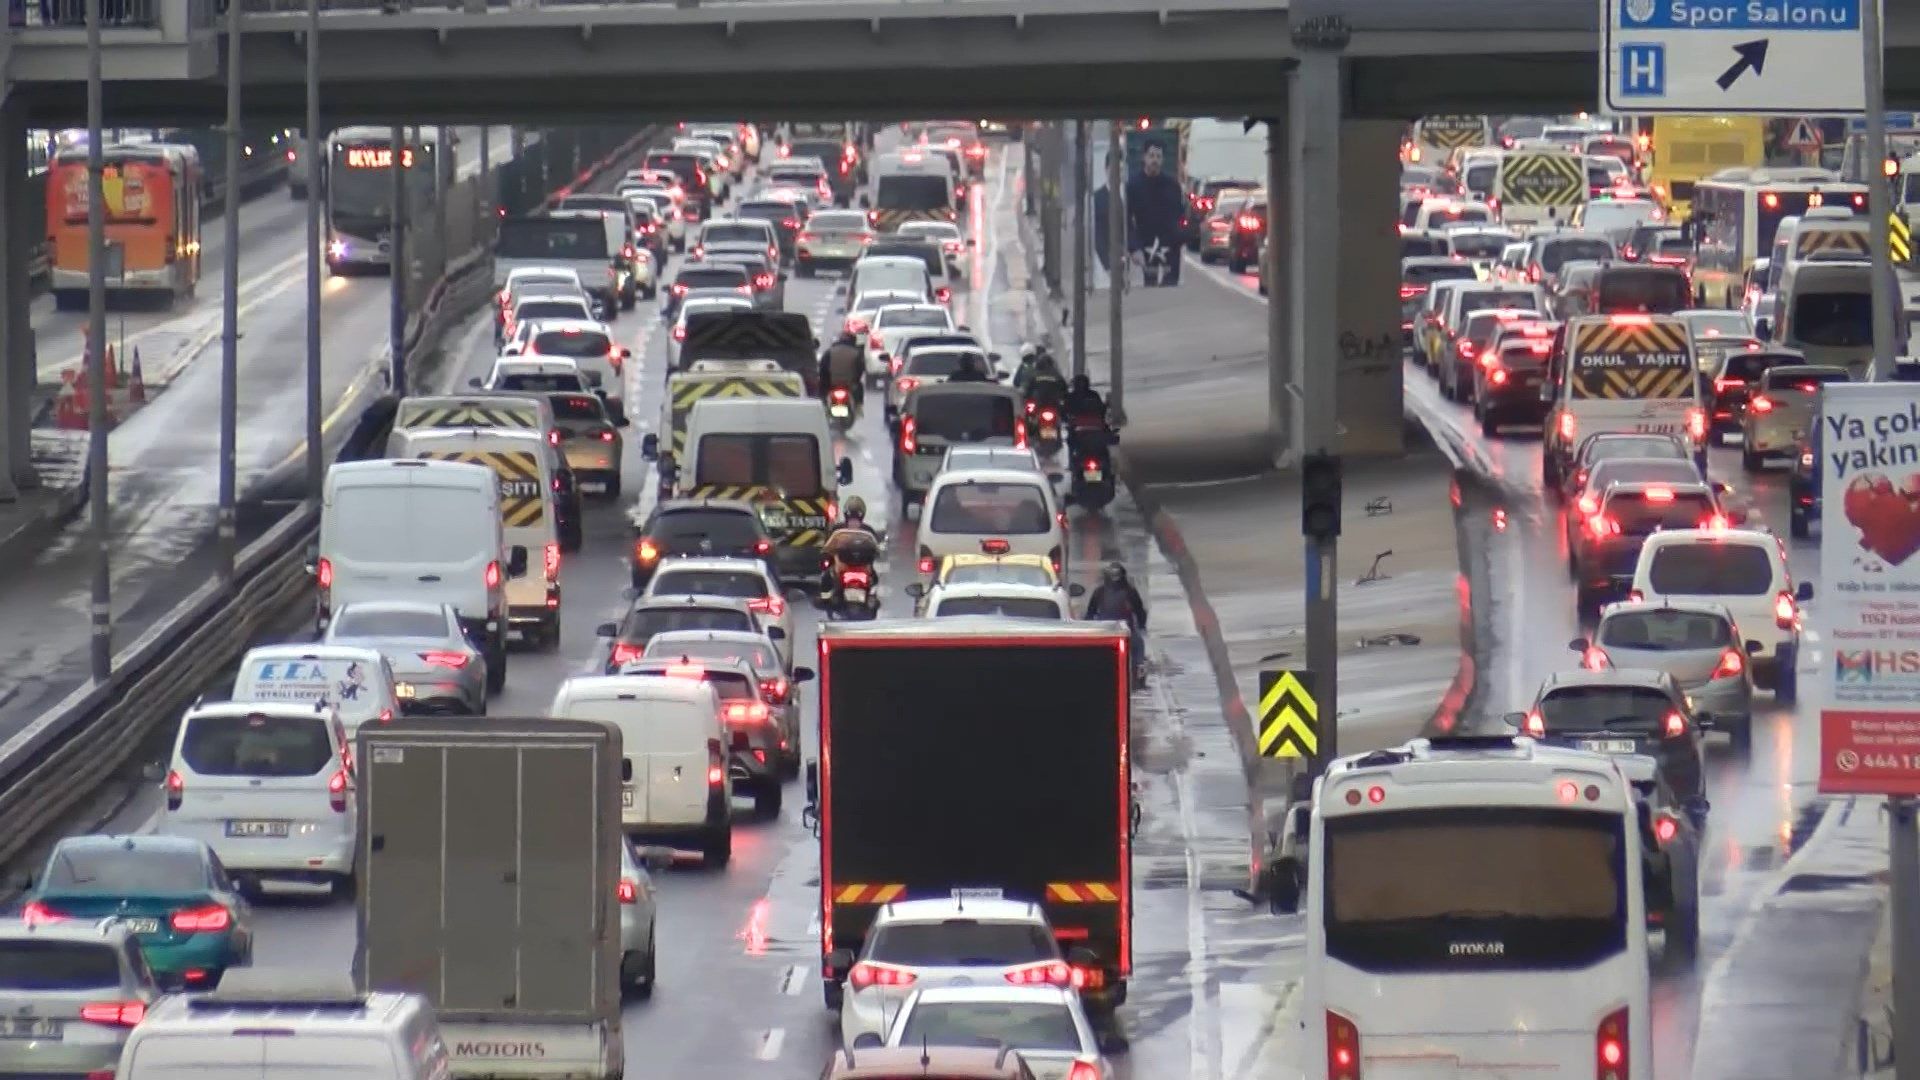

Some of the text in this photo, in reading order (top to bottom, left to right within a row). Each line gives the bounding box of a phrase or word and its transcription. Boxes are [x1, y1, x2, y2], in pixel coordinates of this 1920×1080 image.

[1670, 1, 1846, 27] Spor Salonu
[1630, 49, 1656, 88] H
[1580, 353, 1687, 368] OKUL TAŞITI
[1826, 413, 1866, 442] Ya
[1863, 754, 1899, 768] 444
[1449, 941, 1505, 955] OTOKAR
[456, 1042, 545, 1058] MOTORS
